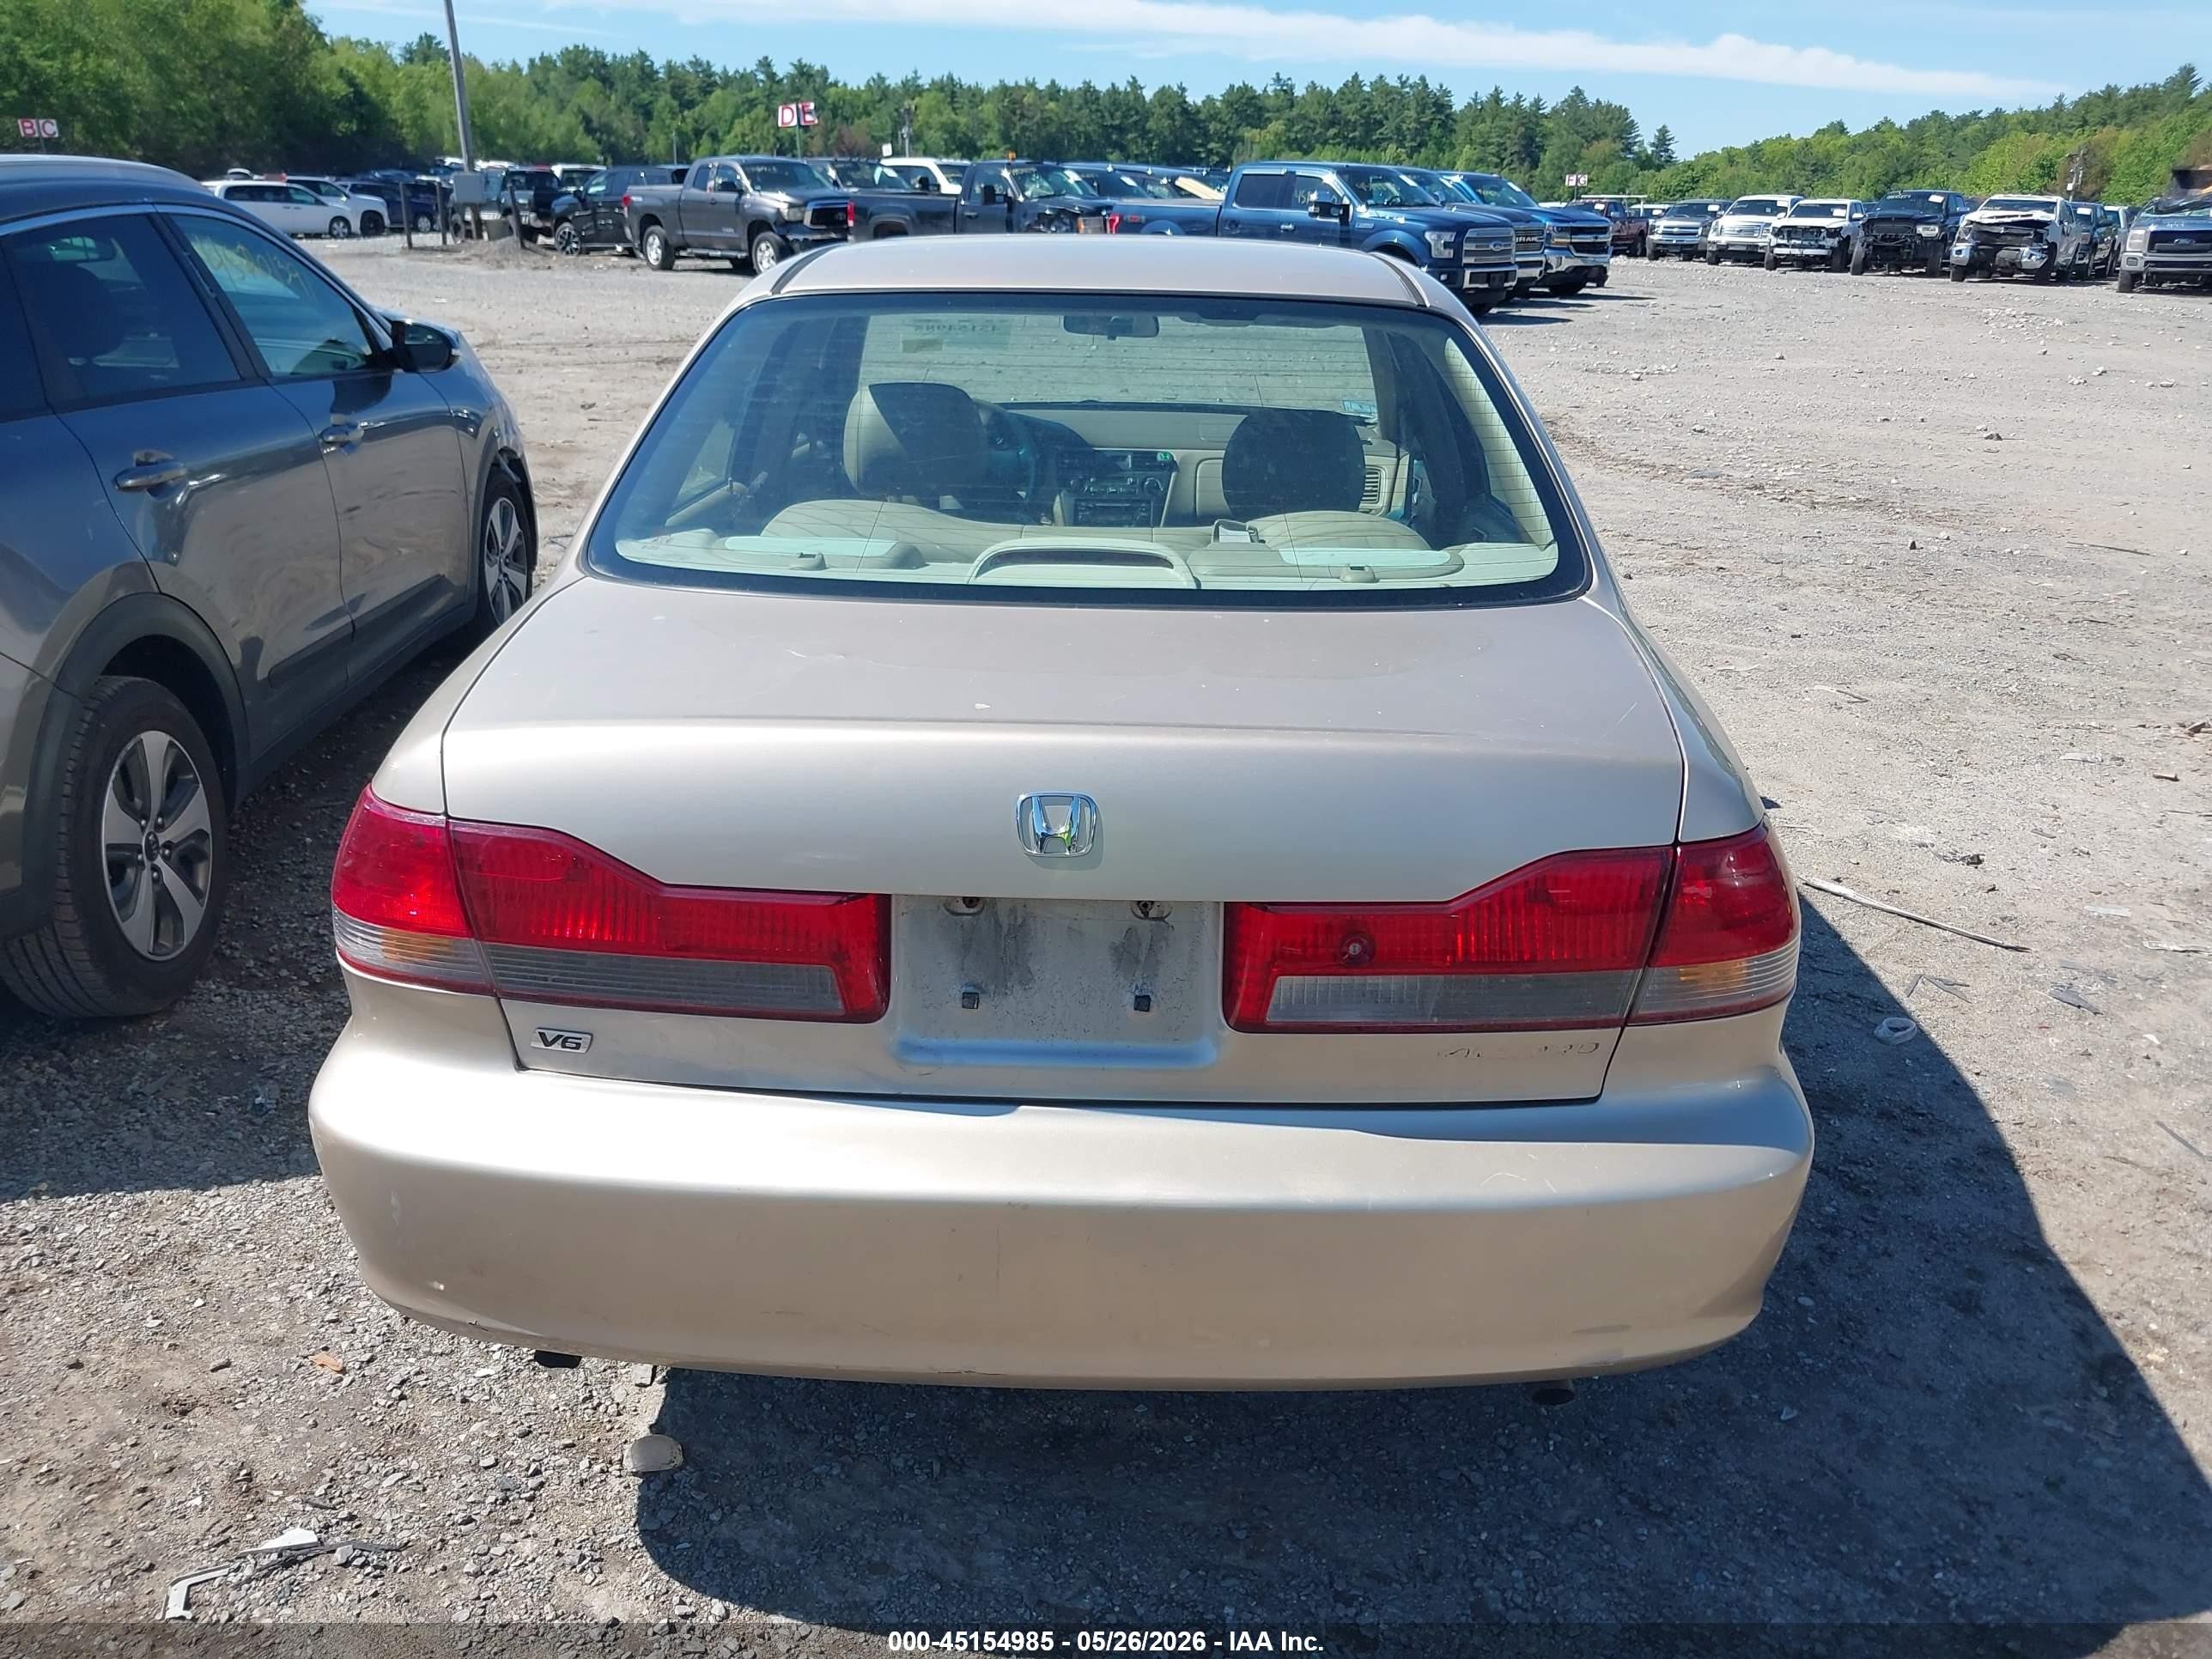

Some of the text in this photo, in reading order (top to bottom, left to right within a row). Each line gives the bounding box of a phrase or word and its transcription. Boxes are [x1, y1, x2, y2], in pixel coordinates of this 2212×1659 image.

[781, 101, 815, 125] D E
[41, 120, 57, 137] C
[538, 1031, 583, 1050] V6
